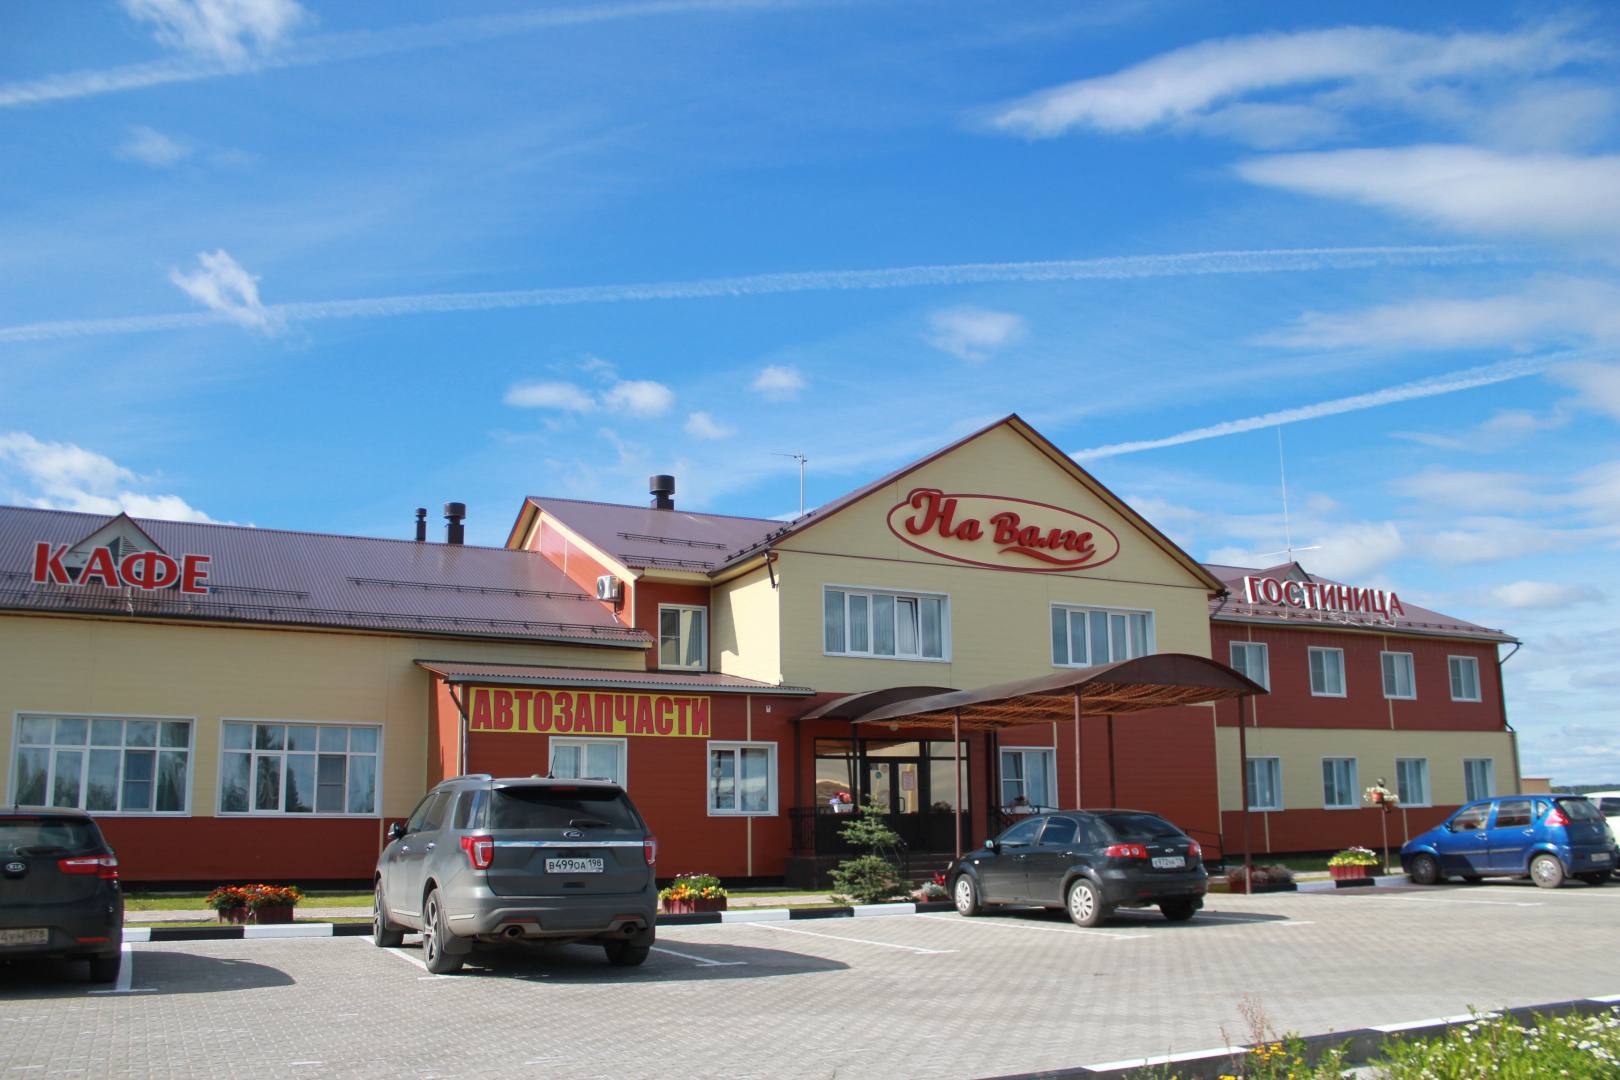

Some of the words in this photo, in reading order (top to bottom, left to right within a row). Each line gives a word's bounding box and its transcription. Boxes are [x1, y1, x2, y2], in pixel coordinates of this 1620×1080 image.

[905, 491, 983, 541] На
[989, 511, 1097, 556] Валге
[32, 541, 212, 595] КАФЕ
[1244, 576, 1405, 620] ГОСТИНИЦА
[471, 689, 710, 736] АВТОЗАПЧАСТИ
[587, 859, 602, 867] 198
